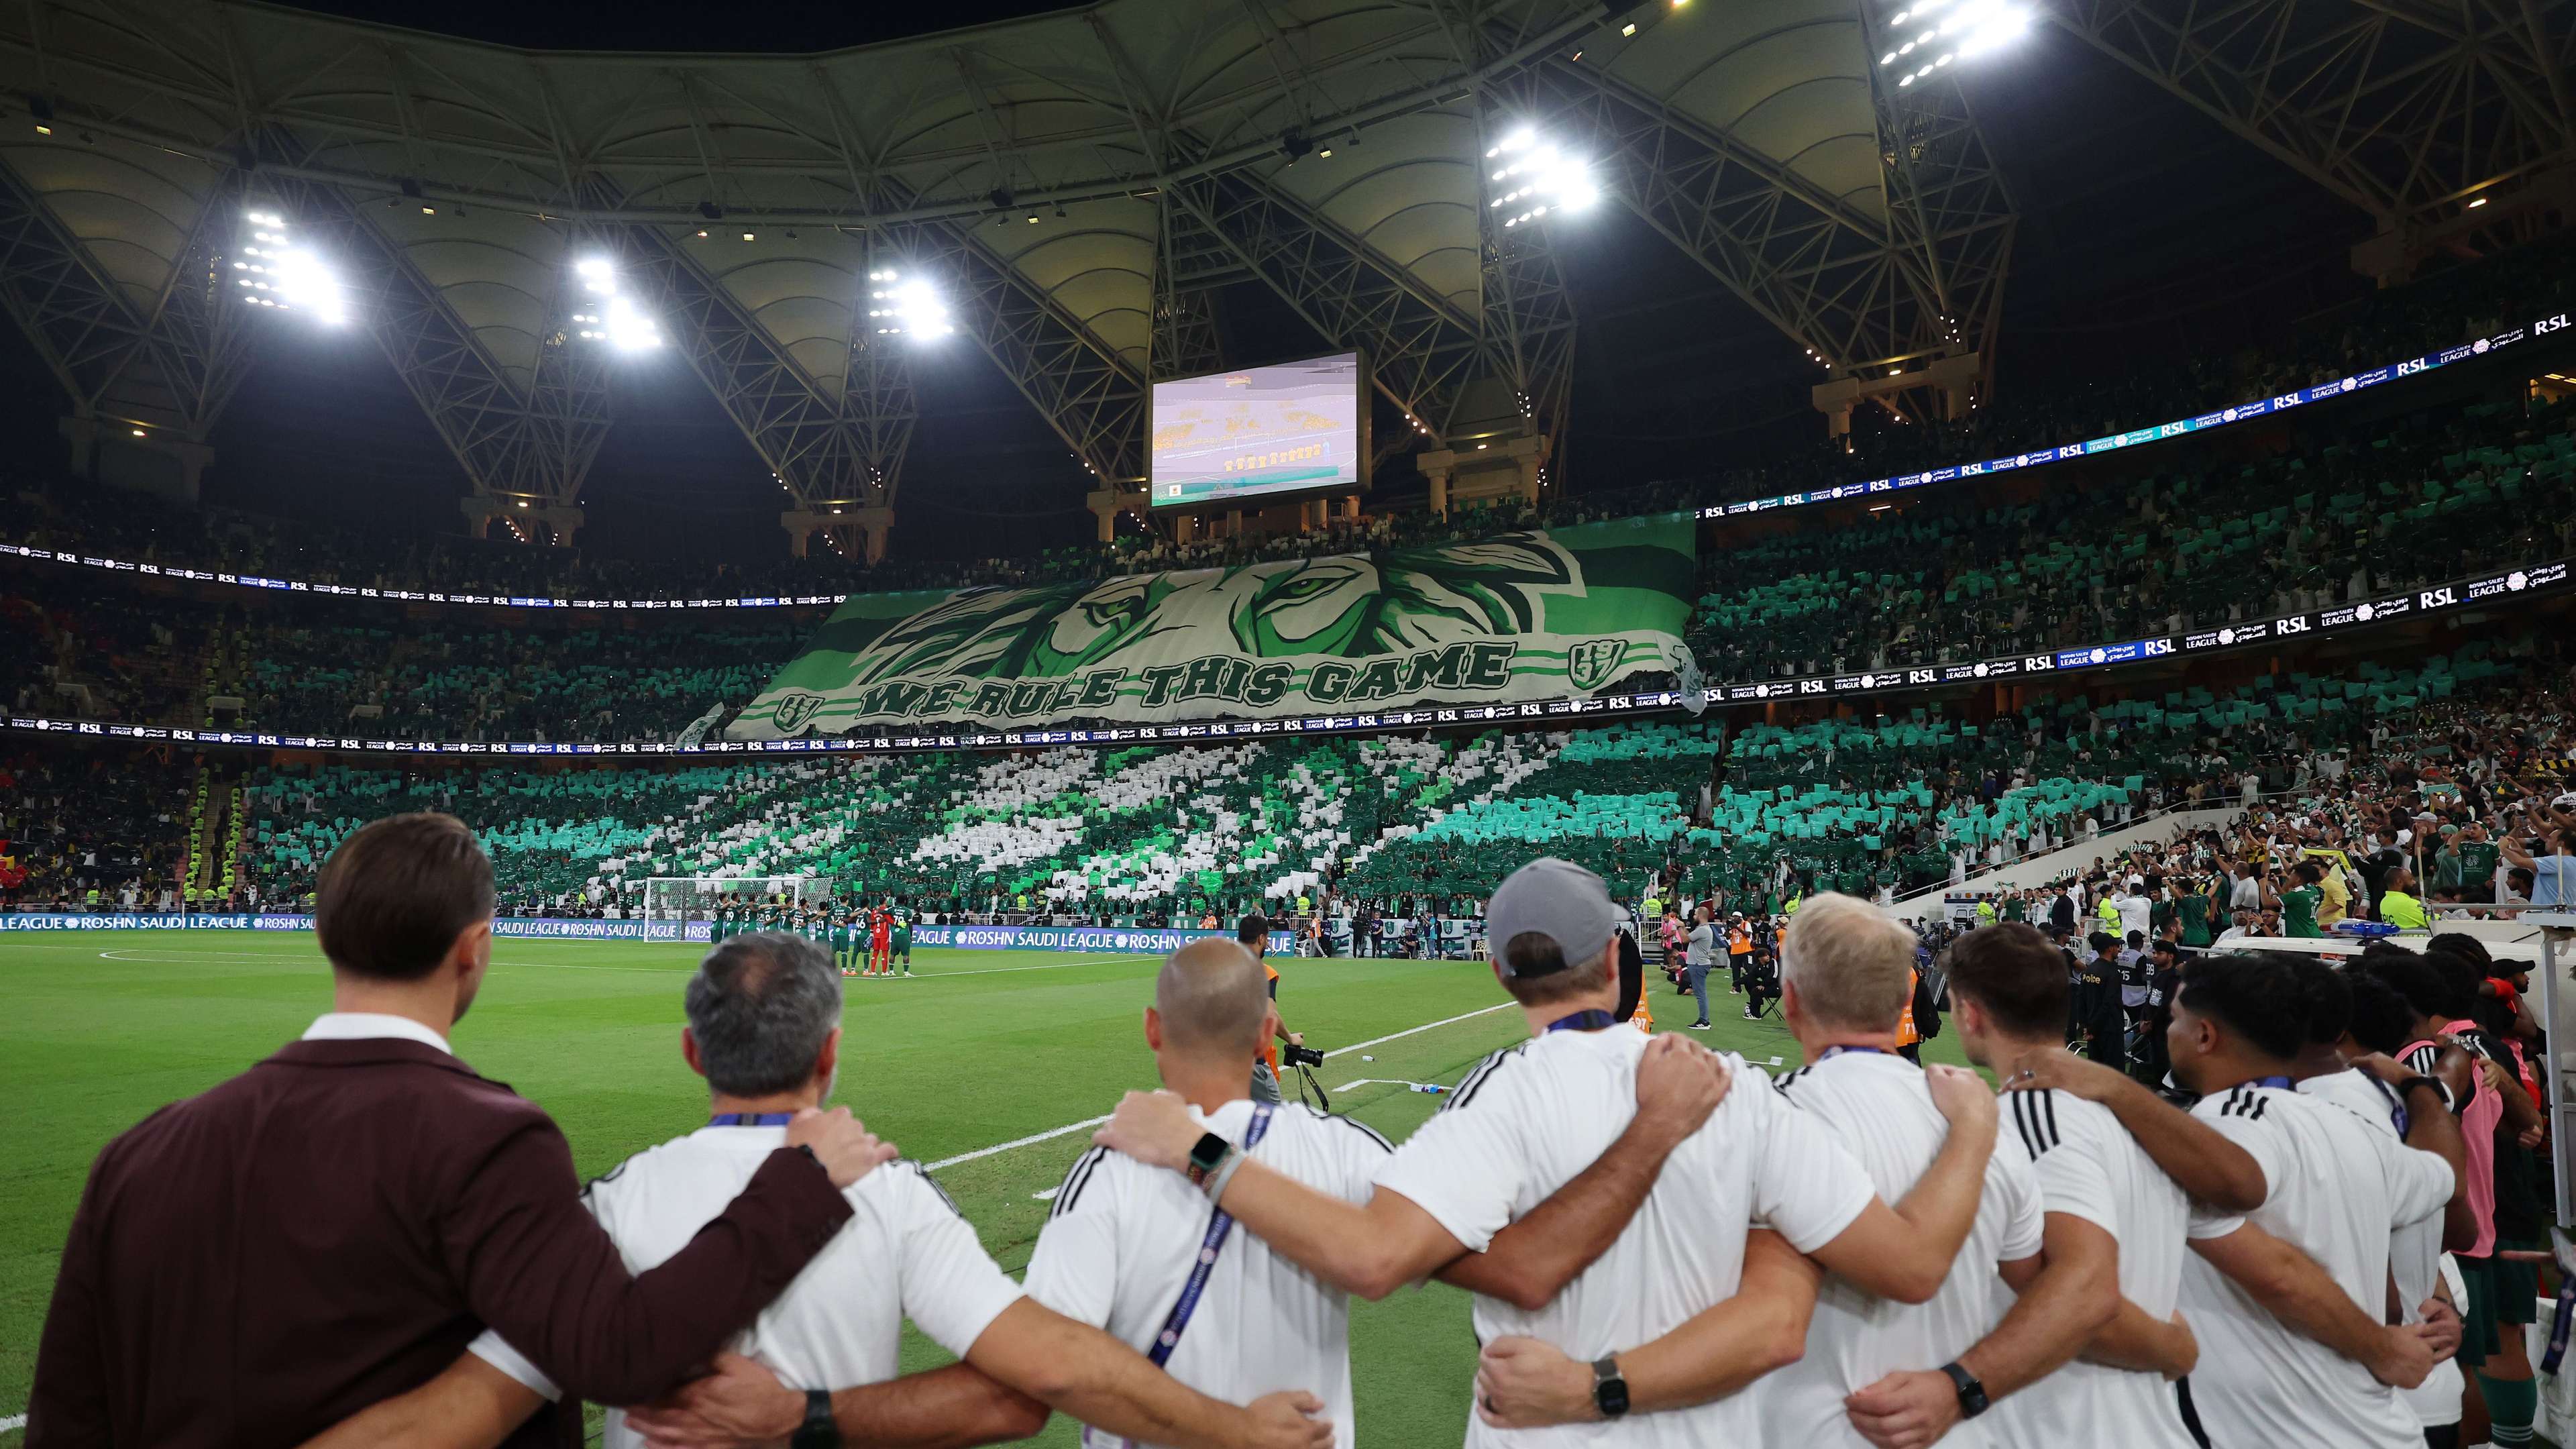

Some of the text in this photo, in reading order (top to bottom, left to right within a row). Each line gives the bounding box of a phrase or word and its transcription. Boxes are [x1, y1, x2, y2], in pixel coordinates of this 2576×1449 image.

[2535, 314, 2571, 335] RSL
[2441, 349, 2470, 363] LEAGUE
[2398, 358, 2429, 376] RSL
[2312, 386, 2341, 399] LEAGUE
[2274, 392, 2303, 410] RSL
[2196, 416, 2222, 428] LEAGUE
[2161, 421, 2188, 437] RSL
[2059, 444, 2084, 458] RSL
[2090, 441, 2113, 451] LEAGUE
[1962, 463, 1985, 476] RSL
[1992, 462, 2015, 470] LEAGUE
[1870, 480, 1892, 492] RSL
[1899, 478, 1919, 486] LEAGUE
[1784, 494, 1805, 506] RSL
[1706, 506, 1725, 518] RSL
[57, 553, 78, 563] RSL
[140, 564, 160, 574] RSL
[219, 574, 237, 583] RSL
[290, 582, 309, 590] RSL
[2470, 582, 2507, 598] LEAGUE
[362, 588, 378, 596] RSL
[429, 593, 445, 601] RSL
[553, 599, 569, 607] RSL
[779, 597, 793, 605] RSL
[2420, 588, 2457, 609] RSL
[2277, 616, 2311, 635] RSL
[2322, 614, 2354, 626] LEAGUE
[2145, 639, 2176, 655] RSL
[2186, 637, 2216, 649] LEAGUE
[2026, 655, 2055, 671] RSL
[2061, 656, 2089, 666] LEAGUE
[857, 641, 1517, 718] WE RULE THIS GAME
[1910, 666, 1937, 684] RSL
[1946, 670, 1972, 679] LEAGUE
[1801, 680, 1827, 693] RSL
[1835, 682, 1860, 690] LEAGUE
[1607, 694, 1632, 709] RSL
[1438, 708, 1460, 721] RSL
[1521, 704, 1542, 716] RSL
[1283, 719, 1303, 731] RSL
[1358, 714, 1377, 727] RSL
[80, 723, 103, 733] RSL
[1140, 727, 1157, 738] RSL
[1210, 723, 1228, 735] RSL
[173, 730, 195, 740] RSL
[258, 735, 279, 745] RSL
[1006, 734, 1022, 743] RSL
[1071, 731, 1088, 741] RSL
[341, 739, 361, 749] RSL
[419, 743, 437, 751] RSL
[748, 742, 763, 751] RSL
[810, 739, 826, 749] RSL
[875, 737, 890, 747] RSL
[940, 737, 955, 746] RSL
[491, 744, 508, 752] RSL
[557, 744, 572, 753] RSL
[621, 744, 637, 752] RSL
[745, 911, 750, 921] 3
[0, 917, 316, 929] LEAGUE ROSHN SAUDI LEAGUE ROSHN SAU
[816, 920, 824, 930] 31
[856, 918, 865, 929] 46
[496, 922, 524, 934] SAUDI
[525, 922, 561, 934] LEAGUE
[572, 923, 605, 936] ROSHN
[606, 924, 637, 936] SAUDI
[638, 924, 676, 937] LAGUE
[690, 926, 711, 938] ROS
[912, 930, 951, 945] EAGUE
[968, 931, 1014, 945] ROSHN
[1018, 932, 1059, 947] SAUDI
[1061, 933, 1112, 948] LEAGUE
[1129, 935, 1180, 949] ROSHN
